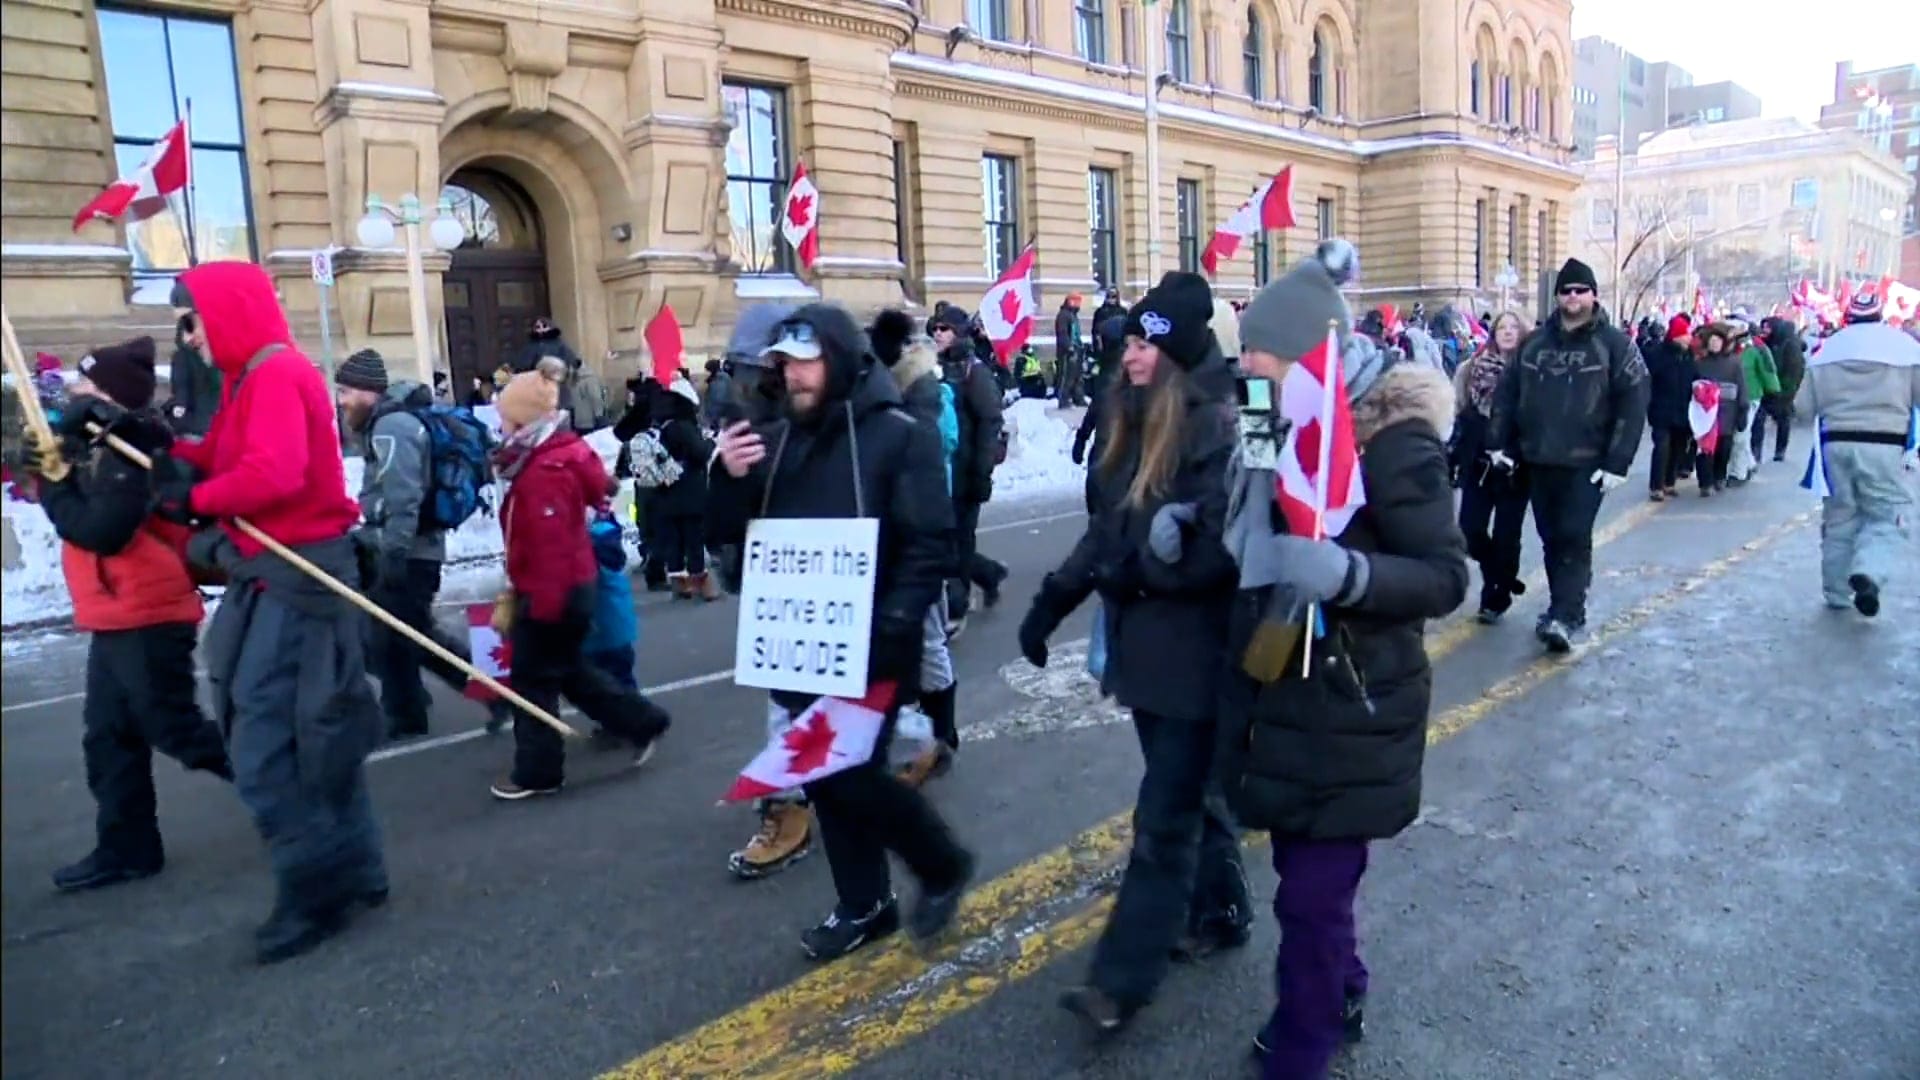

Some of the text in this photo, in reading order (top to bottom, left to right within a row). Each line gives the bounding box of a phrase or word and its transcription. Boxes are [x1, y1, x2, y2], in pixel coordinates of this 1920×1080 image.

[1536, 350, 1587, 366] FXR
[750, 540, 869, 577] Flatten the
[755, 597, 854, 626] curve on
[754, 636, 848, 678] SUICIDE
